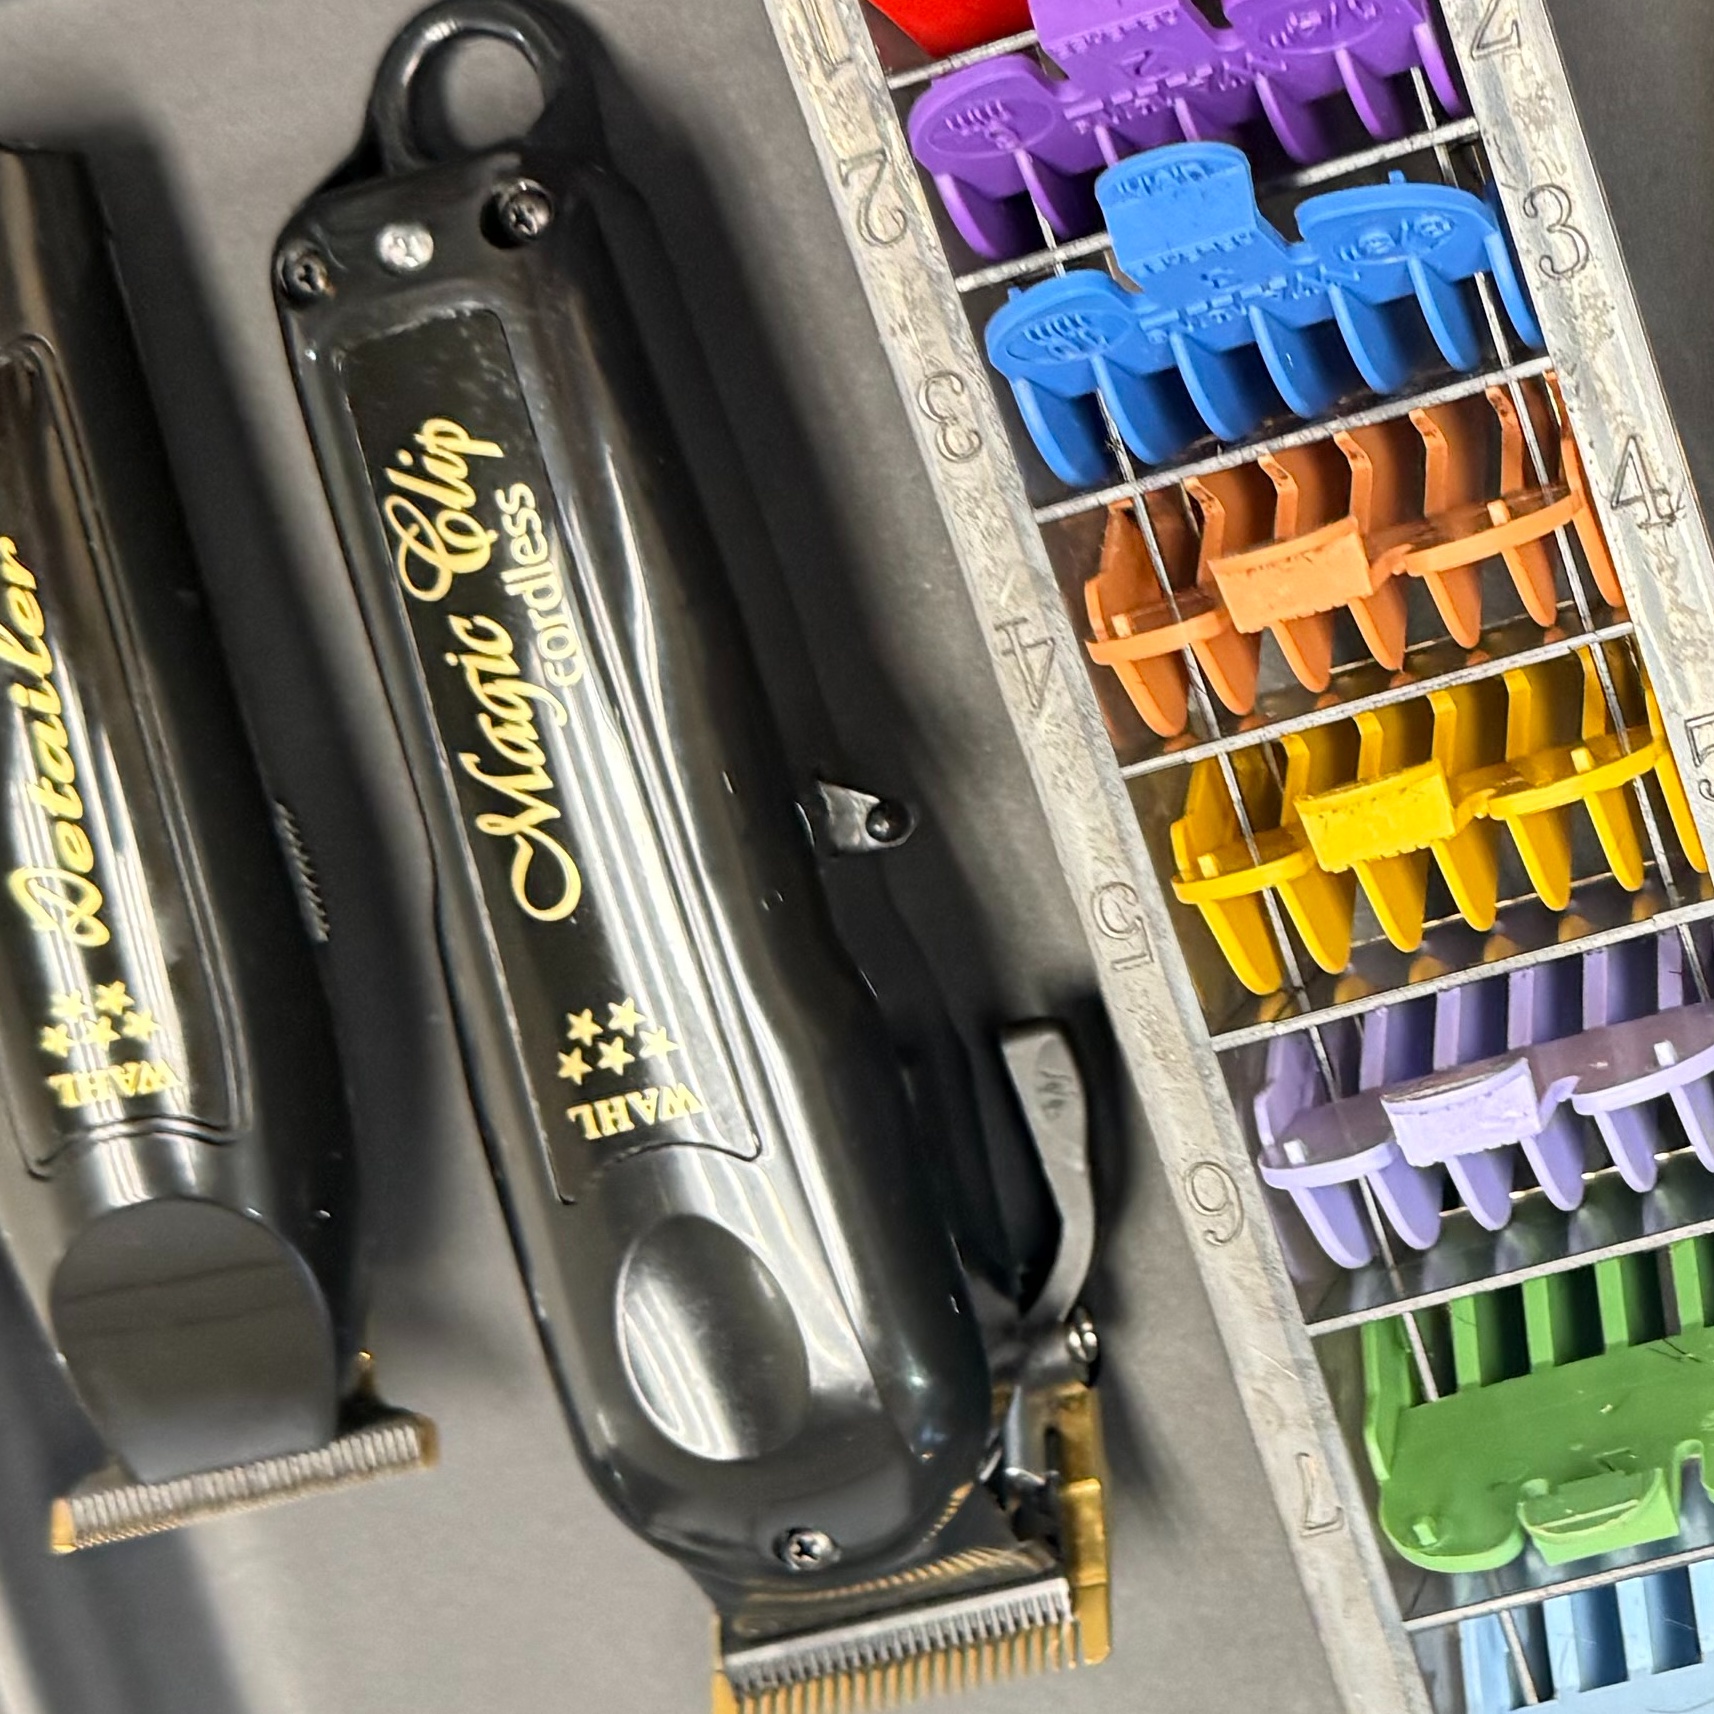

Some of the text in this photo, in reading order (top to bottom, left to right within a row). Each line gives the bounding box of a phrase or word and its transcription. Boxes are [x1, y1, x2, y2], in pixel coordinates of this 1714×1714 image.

[837, 148, 909, 248] 2
[1523, 183, 1589, 281] 3
[917, 370, 983, 464] 3
[1611, 434, 1679, 529] 4
[495, 483, 584, 687] cordless
[385, 417, 581, 922] Magic Clip
[993, 616, 1056, 712] 4
[0, 536, 110, 947] Detailer
[1091, 881, 1156, 972] 5
[46, 1060, 183, 1108] WAHL
[566, 1082, 704, 1140] WAHL
[1296, 1451, 1344, 1538] 7
